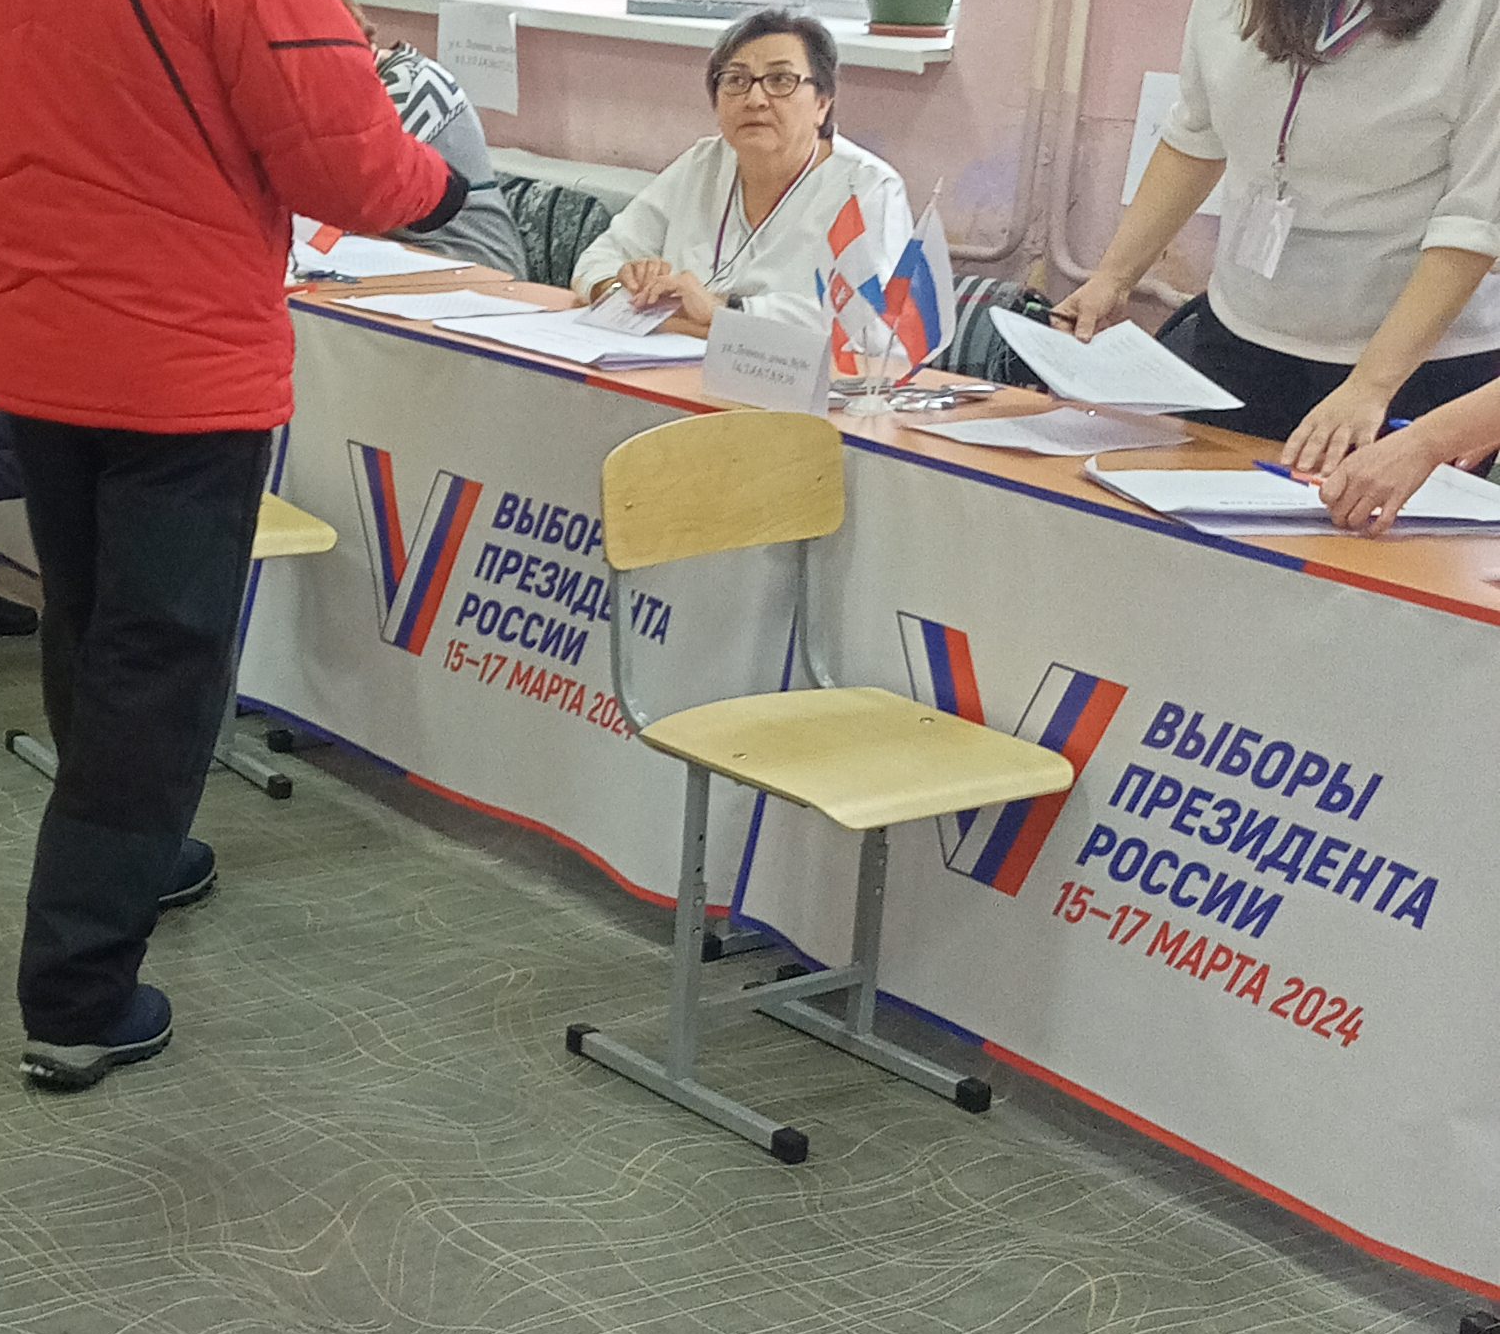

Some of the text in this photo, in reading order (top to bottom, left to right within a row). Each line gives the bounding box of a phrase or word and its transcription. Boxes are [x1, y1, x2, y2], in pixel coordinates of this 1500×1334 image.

[491, 493, 602, 556] ВЫБОР
[455, 592, 589, 665] РОССИИ
[505, 664, 587, 718] МАРТА
[1141, 701, 1383, 821] ВЫБОРЫ
[1076, 823, 1284, 940] РОССИИ
[1107, 763, 1439, 930] ПРЕЗИДЕНТА
[1146, 921, 1272, 1005] МАРТА
[1269, 976, 1364, 1048] 2024
